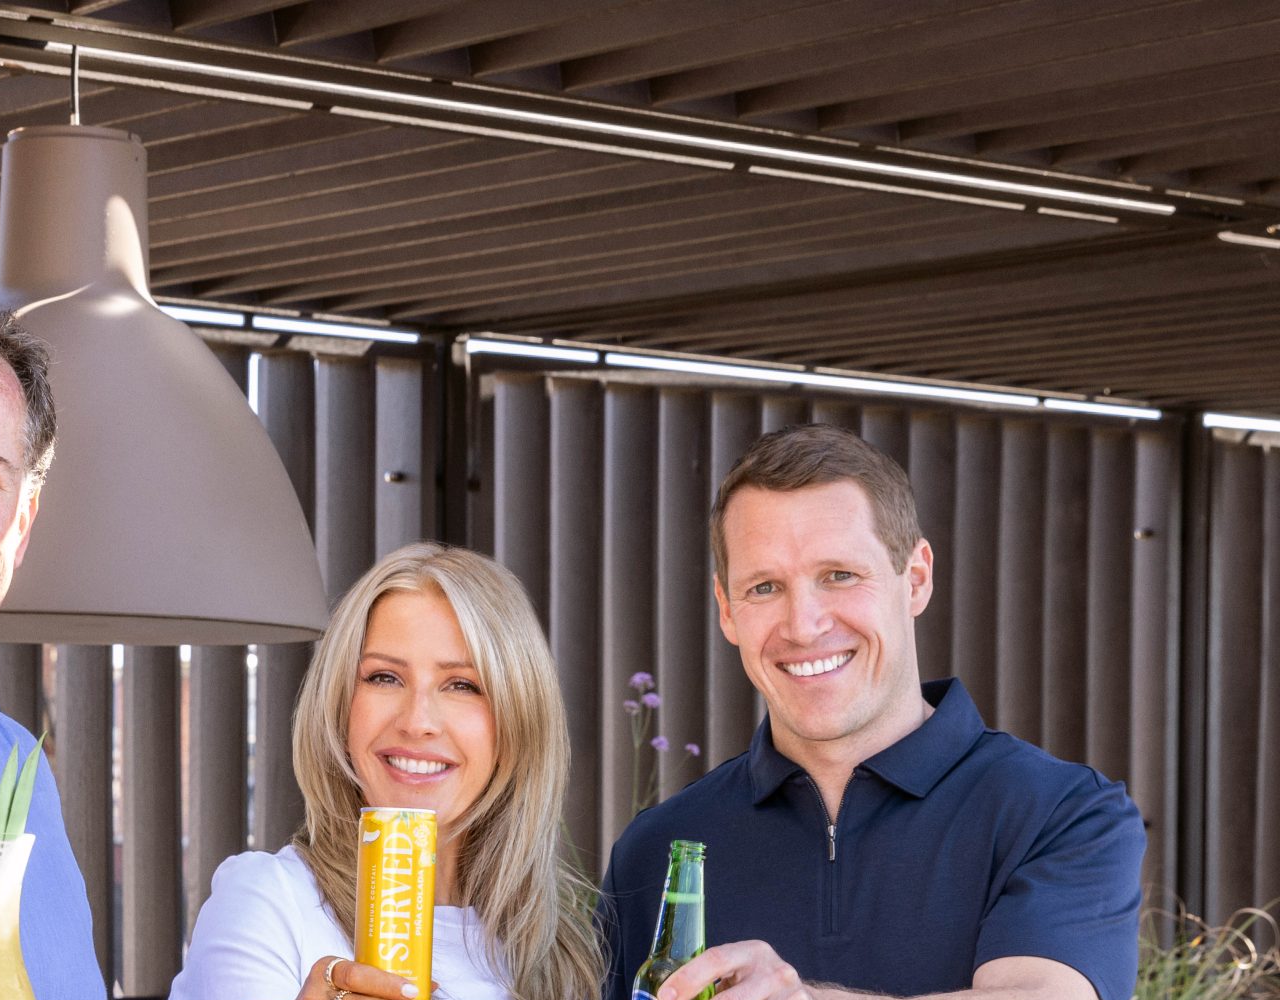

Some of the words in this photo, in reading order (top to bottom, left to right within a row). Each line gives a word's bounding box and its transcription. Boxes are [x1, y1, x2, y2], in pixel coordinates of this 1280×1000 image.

[369, 863, 377, 900] COCKTAIL
[378, 832, 414, 962] SERVED
[416, 869, 425, 911] COLADA
[414, 913, 423, 936] PIÑA
